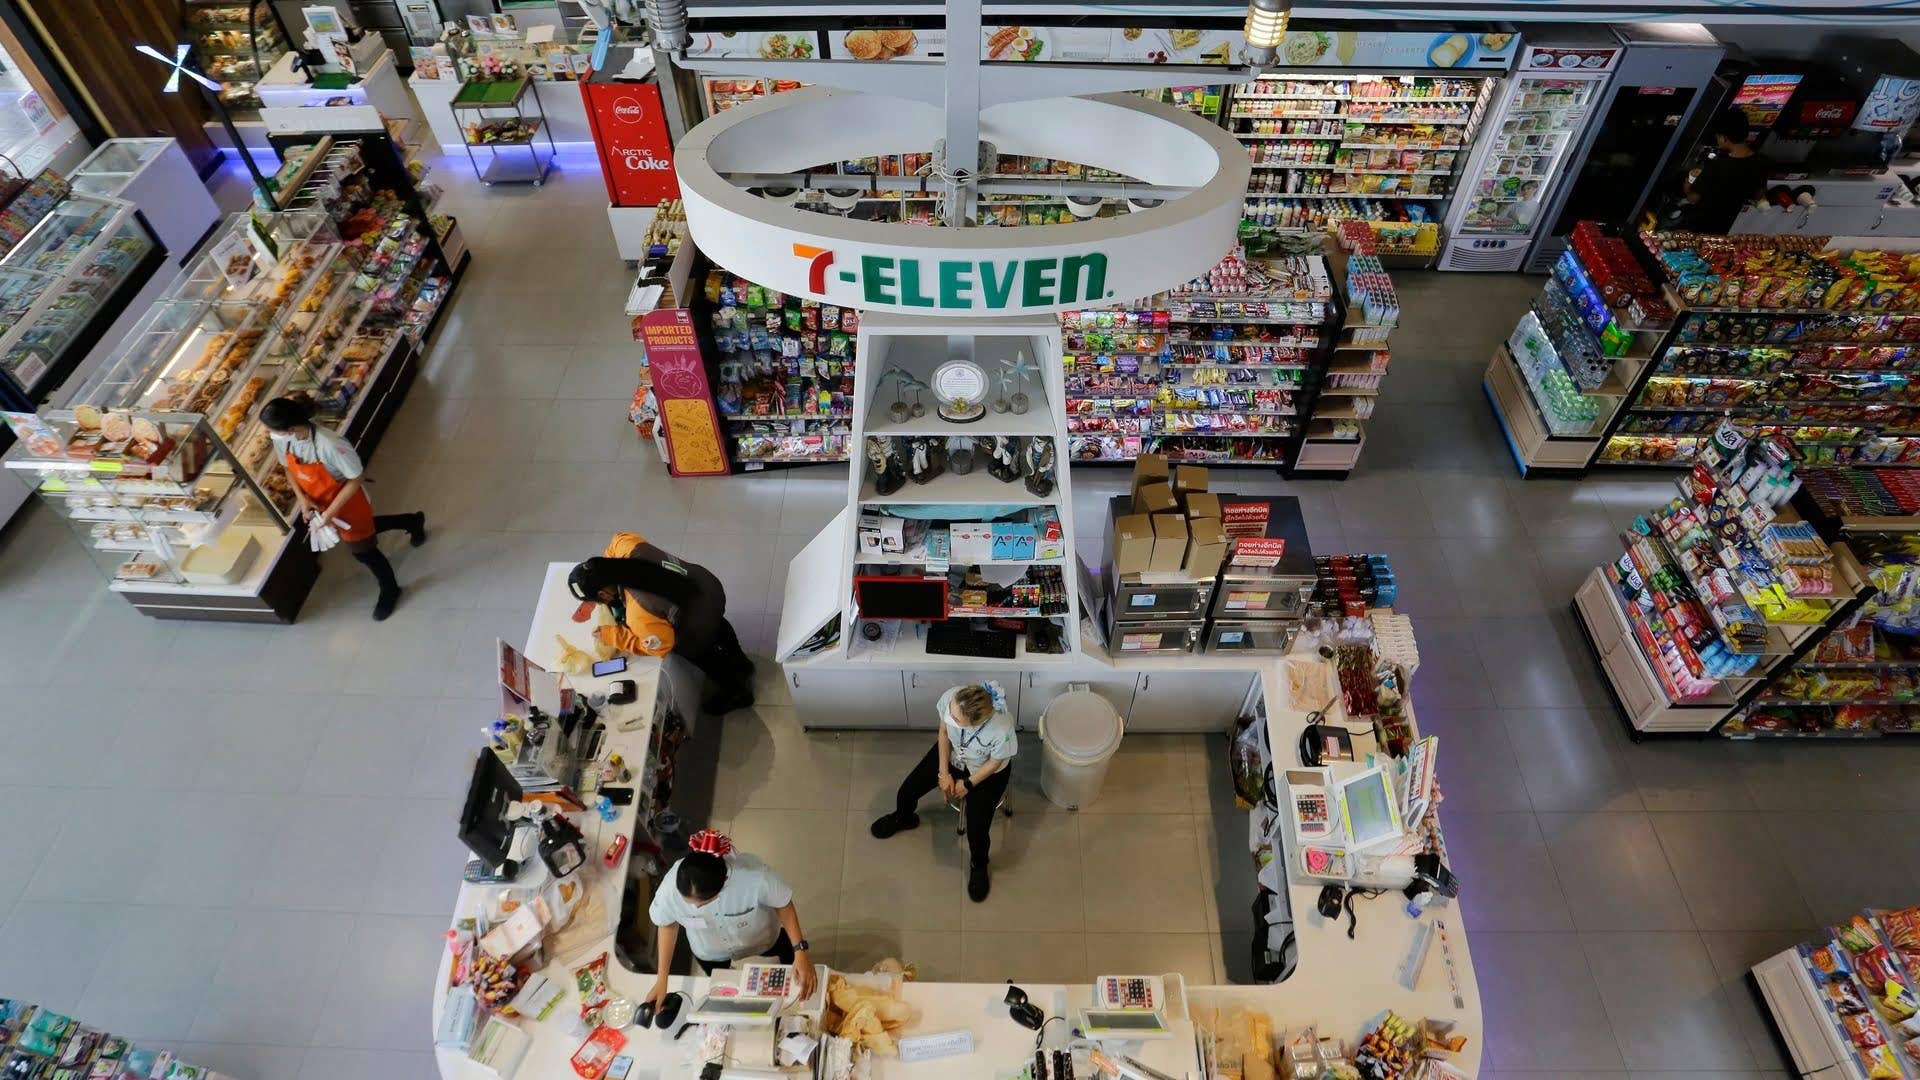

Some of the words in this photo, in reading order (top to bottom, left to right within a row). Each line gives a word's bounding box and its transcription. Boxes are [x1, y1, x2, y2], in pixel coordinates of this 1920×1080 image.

[611, 146, 652, 156] ARCTIC
[625, 156, 669, 170] Coke
[644, 325, 692, 335] IMPORTED
[647, 335, 695, 345] PRODUCTS
